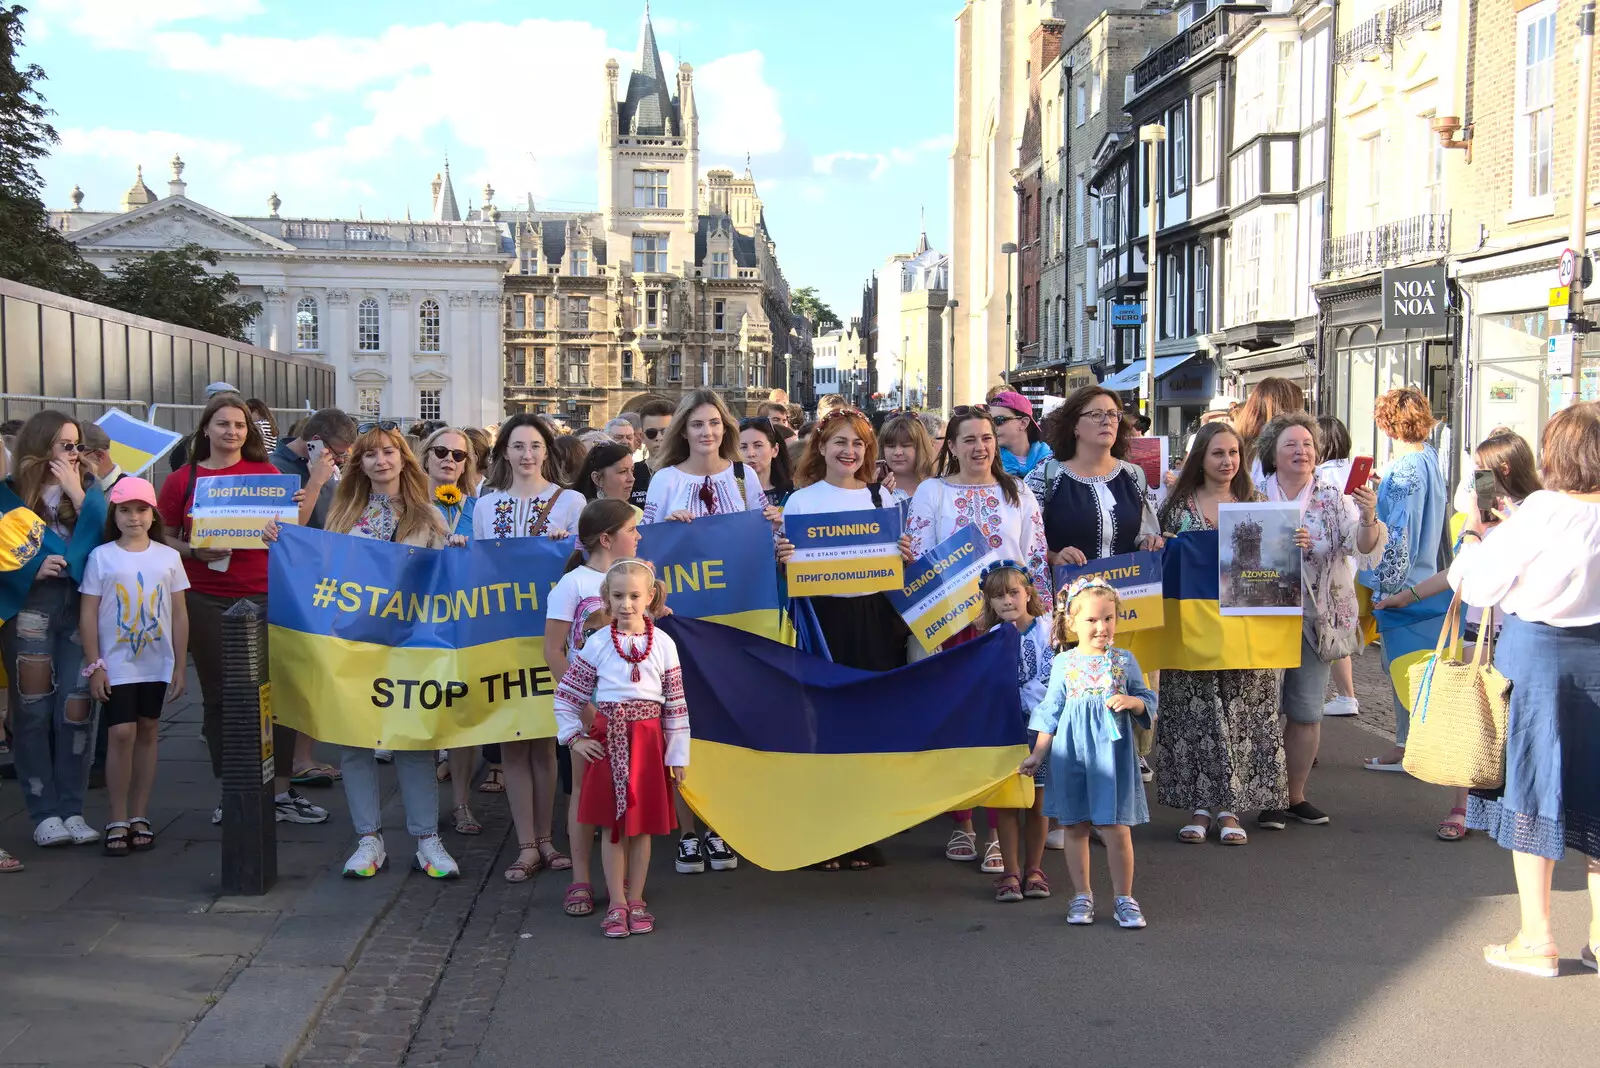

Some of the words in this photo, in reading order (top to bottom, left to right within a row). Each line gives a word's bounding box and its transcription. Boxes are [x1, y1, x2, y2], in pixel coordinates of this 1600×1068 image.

[1561, 259, 1572, 276] 20
[1393, 298, 1436, 316] NOA
[208, 487, 286, 498] DIGITALISED
[807, 522, 880, 539] STUNNING
[796, 568, 895, 583] ПРИГОЛОМШЛИВА
[902, 541, 975, 598] DEMOCRATIC
[928, 589, 946, 604] STAND
[946, 579, 961, 591] WITH
[961, 562, 985, 580] UKRAINE
[370, 677, 469, 710] STOP
[480, 666, 554, 704] THE
